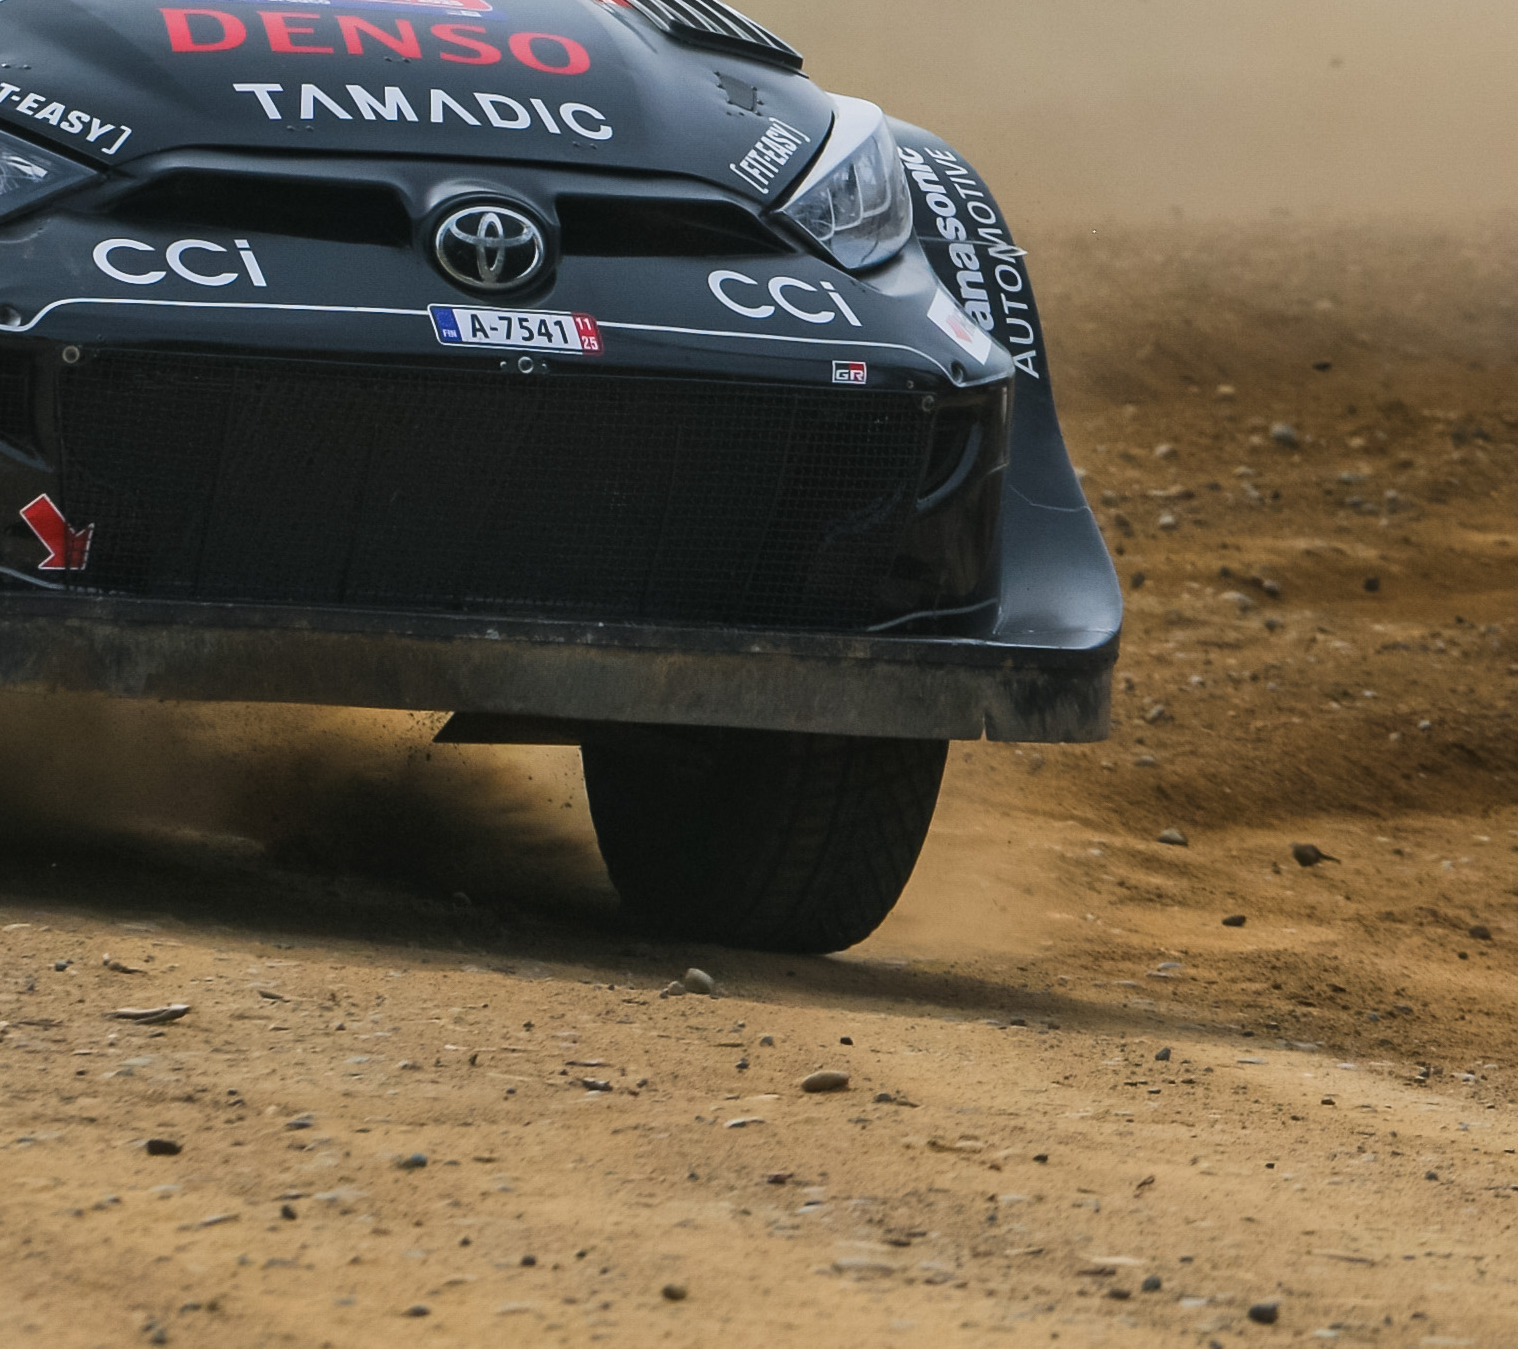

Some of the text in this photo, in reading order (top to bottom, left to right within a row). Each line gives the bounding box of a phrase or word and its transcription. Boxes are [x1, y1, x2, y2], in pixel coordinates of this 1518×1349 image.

[158, 7, 592, 76] DENSO
[232, 83, 614, 142] TAMADIC
[92, 238, 266, 287] CCi
[897, 146, 995, 332] anasonic
[923, 146, 1040, 380] AUTOMOTIVE
[707, 269, 863, 327] CCi
[470, 314, 569, 345] A-7541
[575, 317, 593, 331] 11
[582, 336, 599, 351] 25
[835, 369, 866, 383] GR
